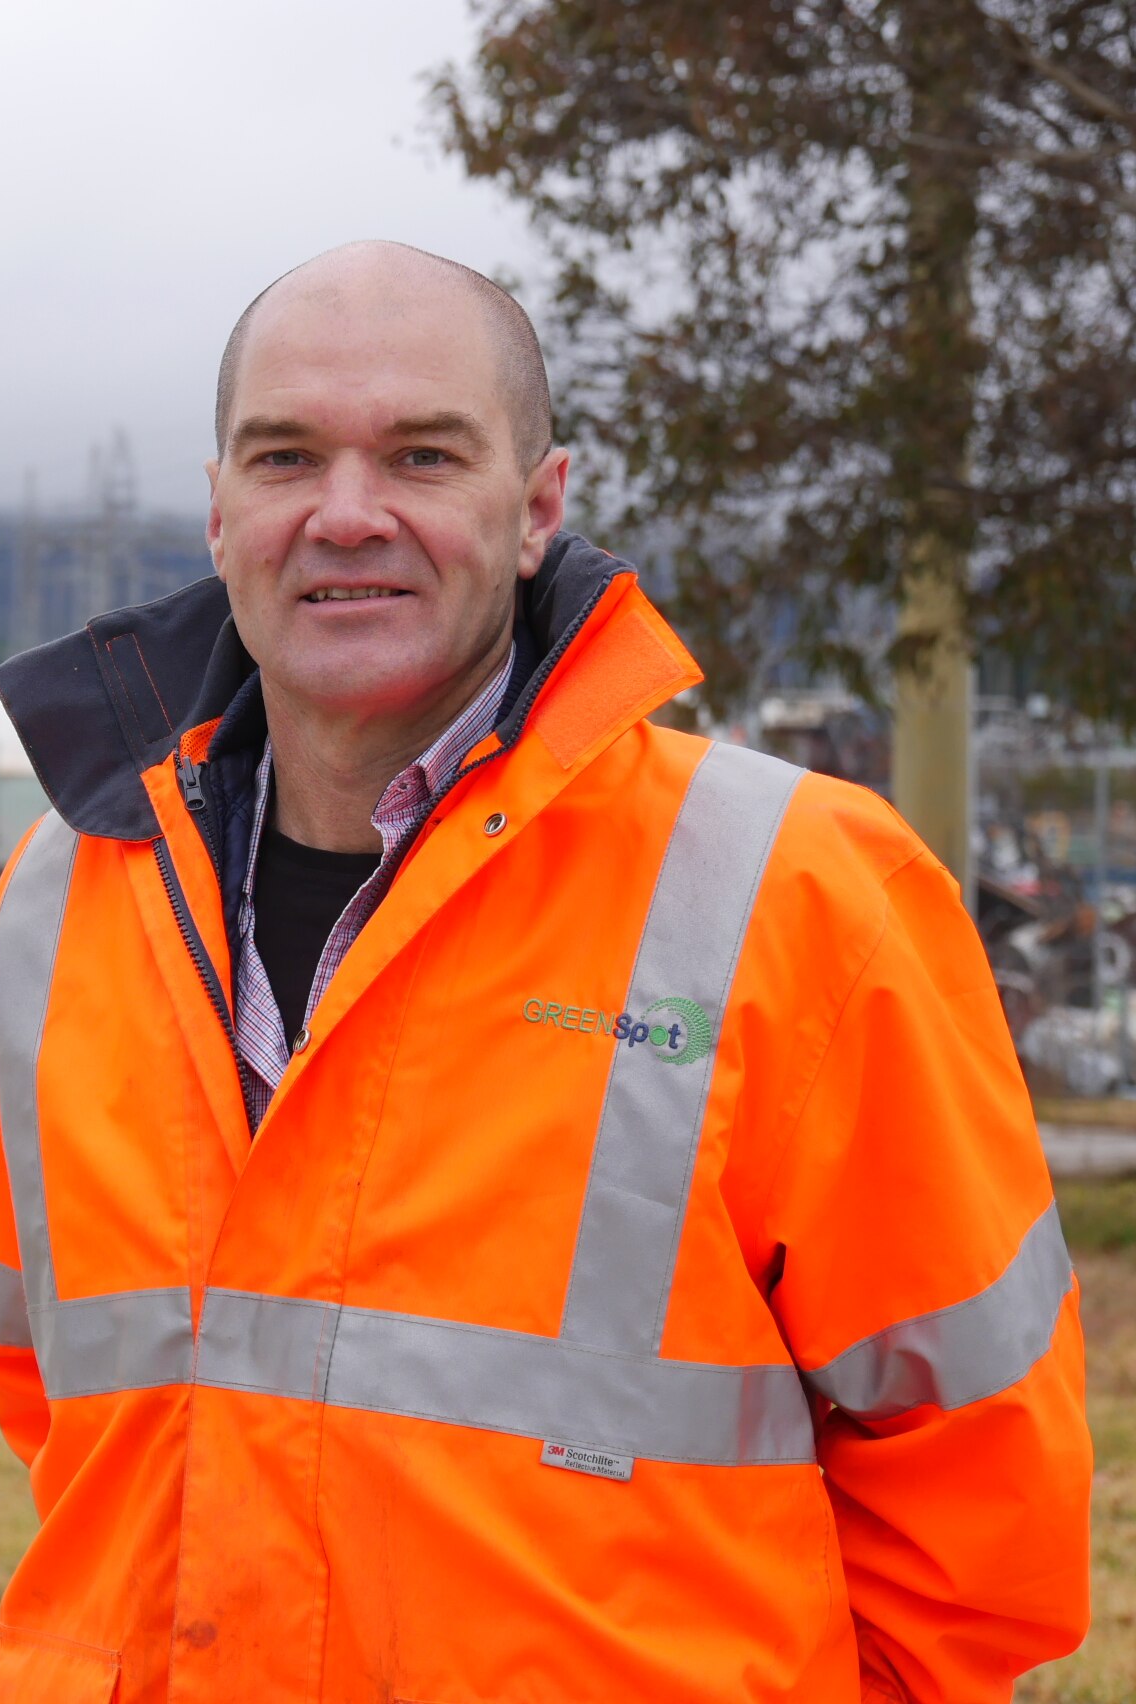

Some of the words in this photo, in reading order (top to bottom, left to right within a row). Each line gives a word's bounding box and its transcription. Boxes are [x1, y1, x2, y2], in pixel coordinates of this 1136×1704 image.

[548, 1445, 565, 1457] 3M
[564, 1460, 596, 1472] Reflective
[596, 1466, 625, 1478] Material
